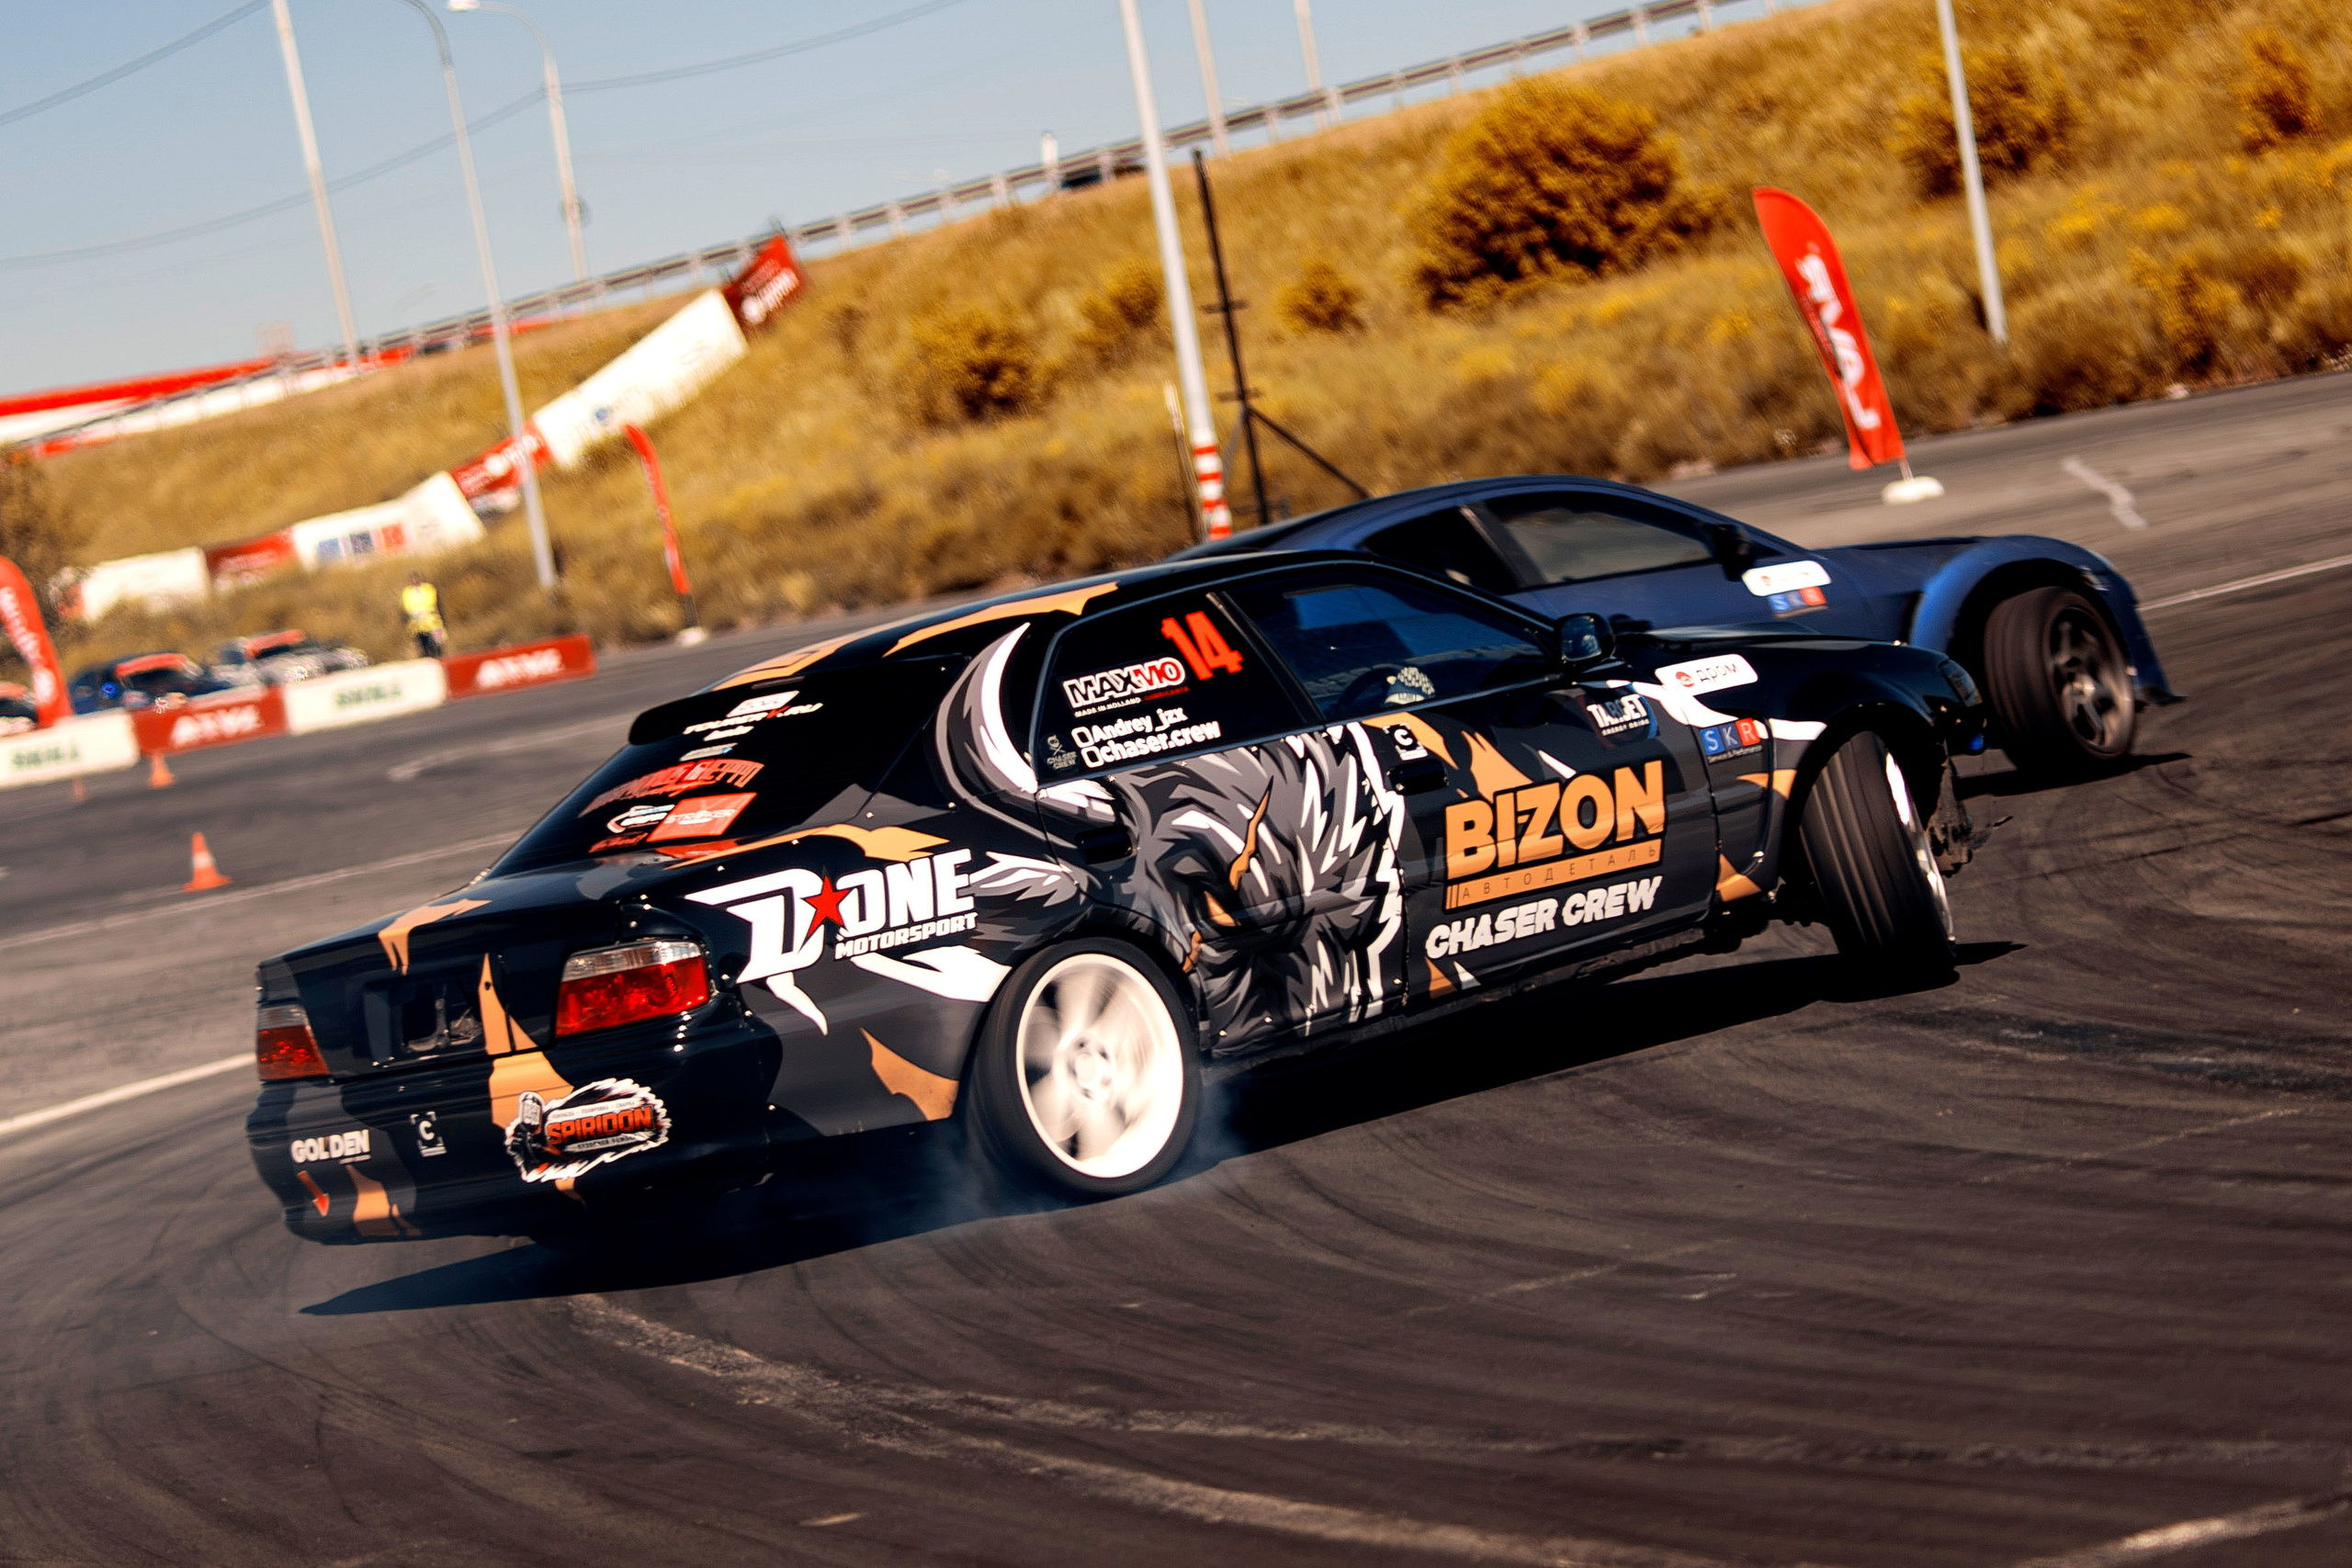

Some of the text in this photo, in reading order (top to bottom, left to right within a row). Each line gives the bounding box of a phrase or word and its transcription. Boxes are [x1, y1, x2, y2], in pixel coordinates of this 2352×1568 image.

[1160, 610, 1243, 681] 14
[1074, 707, 1098, 718] MADE
[1097, 705, 1107, 714] IN
[1106, 696, 1142, 711] HOLLAND
[1091, 707, 1189, 744] Andrey_jzx
[1101, 720, 1222, 763] chaser.crew
[1702, 720, 1758, 752] SKR
[1053, 759, 1077, 770] CREW
[1445, 760, 1666, 880] BIZON
[1462, 845, 1657, 901] АВТОДЕТАЛЬ
[833, 911, 978, 961] MOTORSPORT
[1425, 875, 1663, 959] CHASER CREW
[547, 1105, 655, 1145] SPIRIDON
[290, 1129, 371, 1164] GOLDEN
